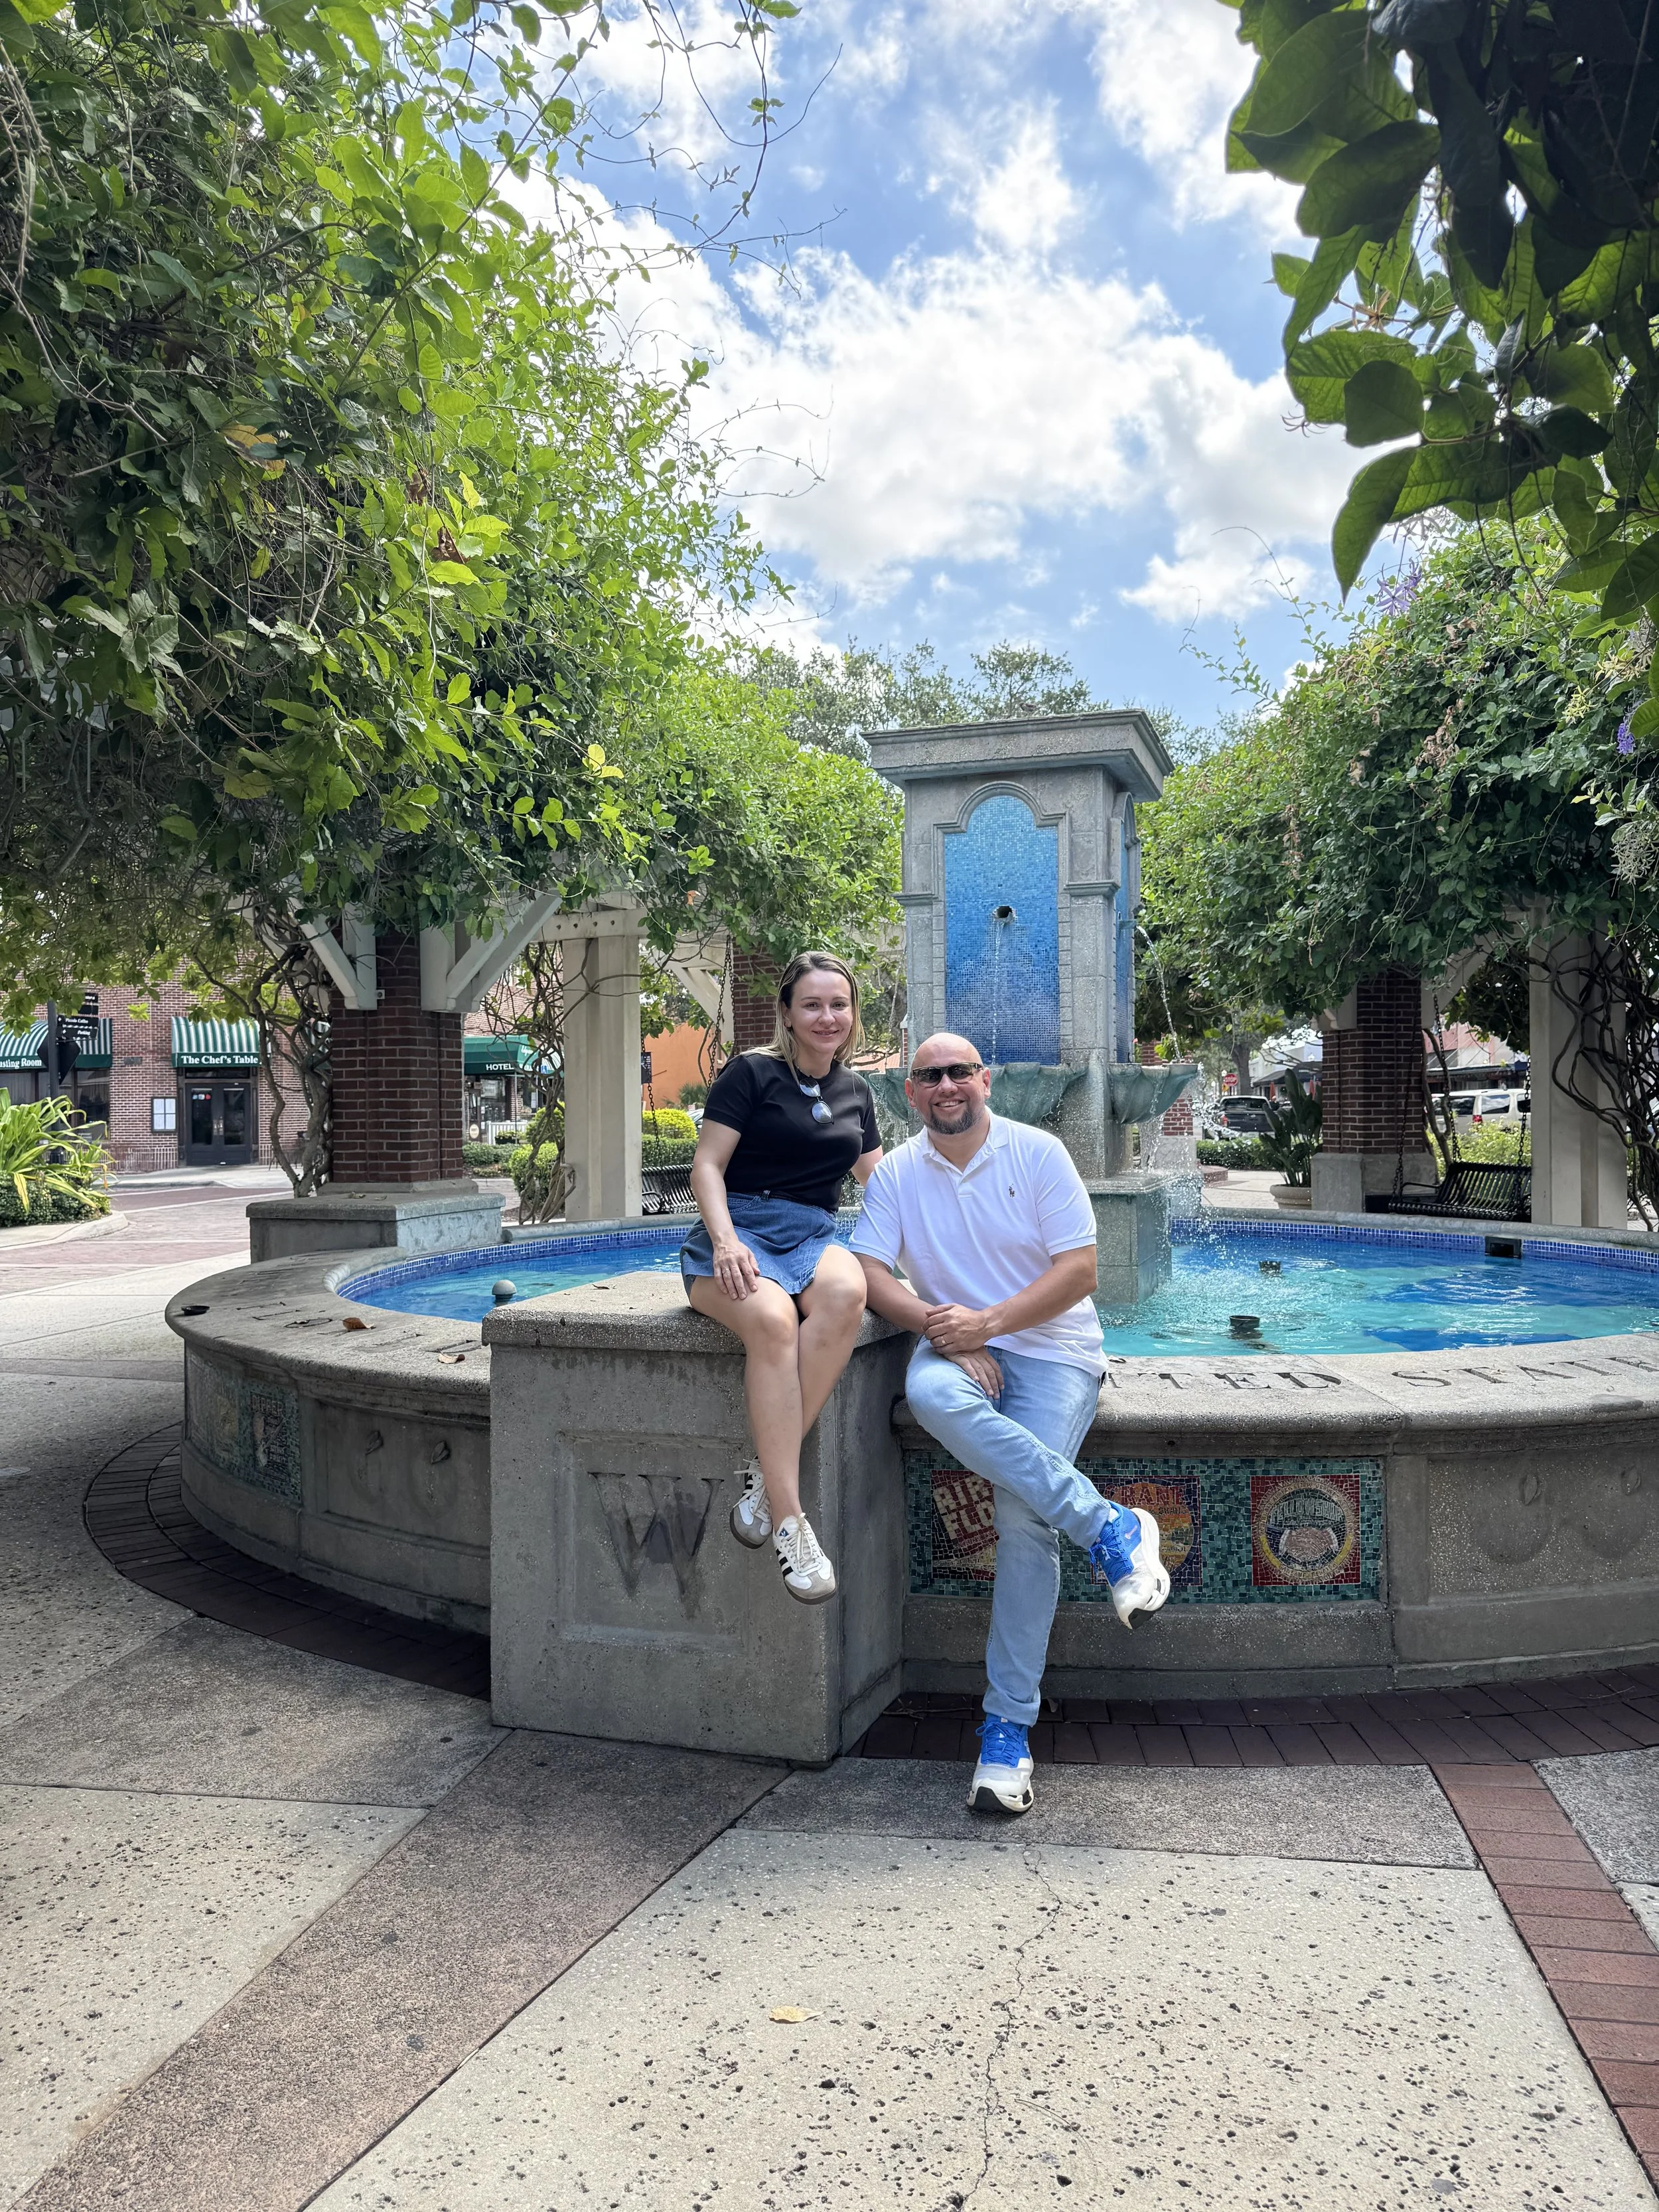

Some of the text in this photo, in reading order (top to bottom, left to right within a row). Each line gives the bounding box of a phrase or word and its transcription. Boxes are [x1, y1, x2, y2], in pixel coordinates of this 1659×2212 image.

[0, 1058, 42, 1069] sting Room
[180, 1055, 259, 1064] The Chef's Table
[1108, 1372, 1342, 1390] ITED
[1269, 1498, 1346, 1525] FELLOWSHIP
[587, 1471, 725, 1620] W
